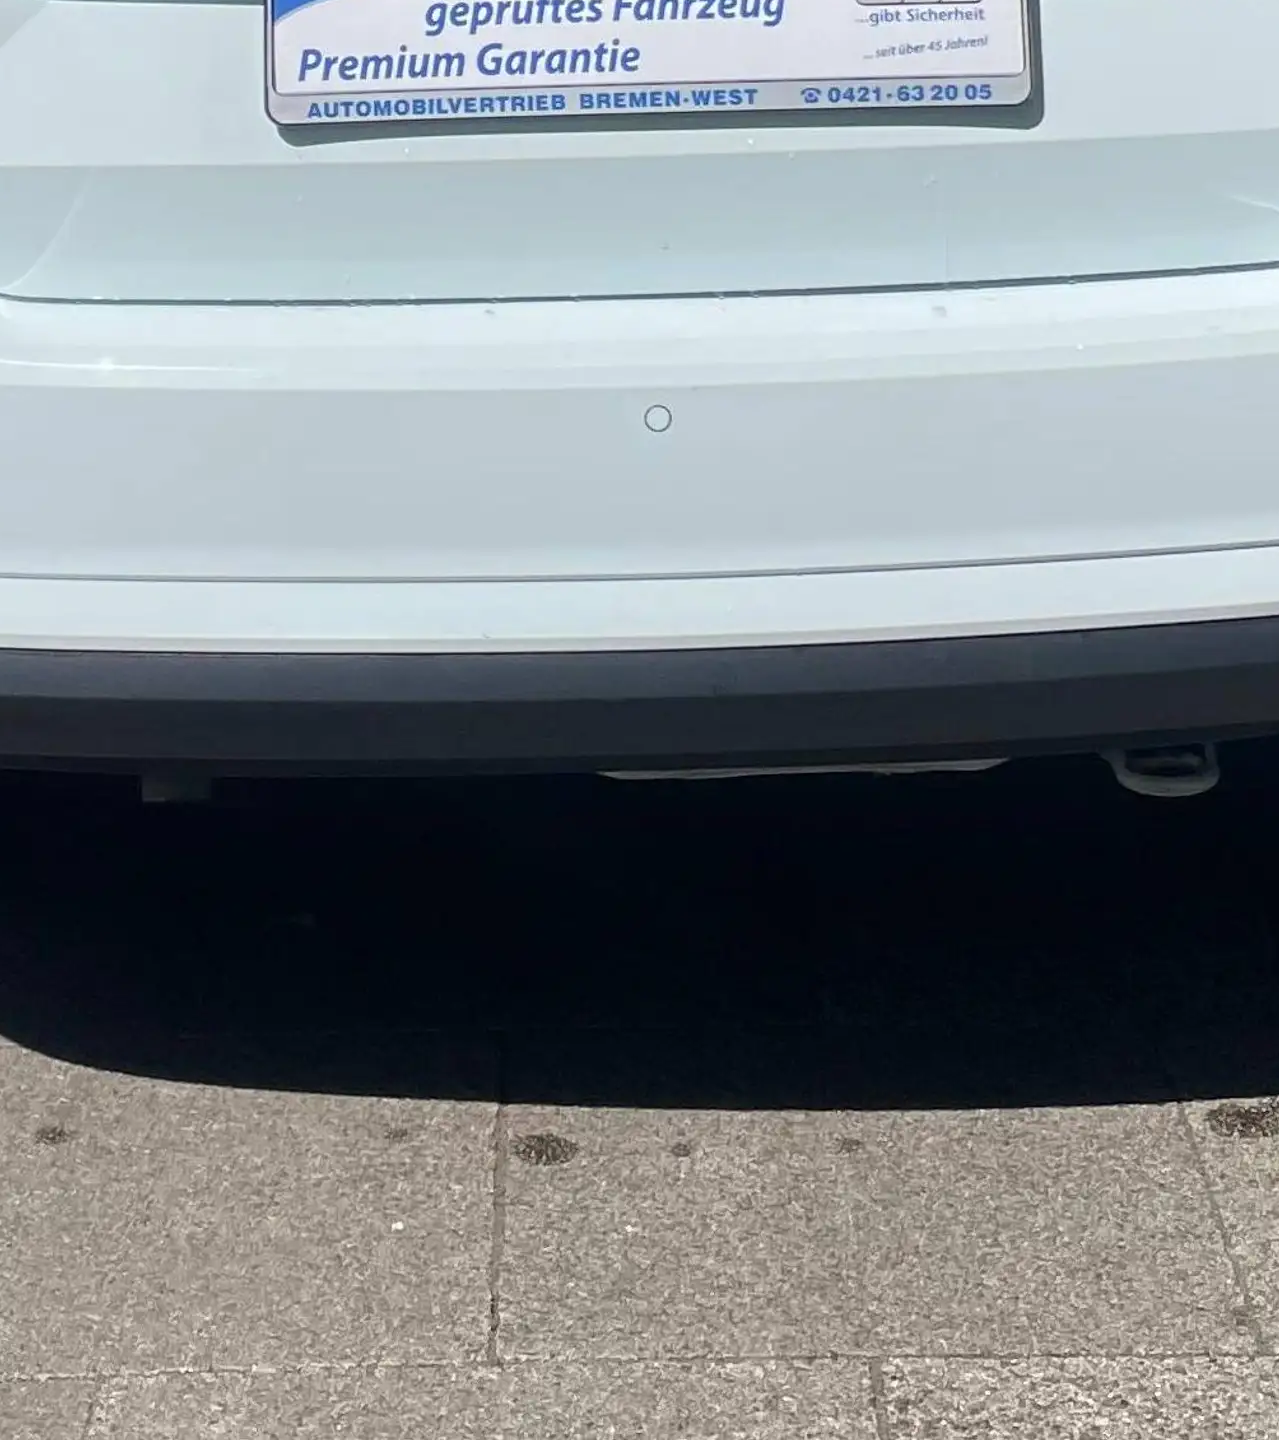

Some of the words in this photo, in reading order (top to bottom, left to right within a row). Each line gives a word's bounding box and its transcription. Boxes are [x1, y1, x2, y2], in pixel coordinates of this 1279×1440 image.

[907, 7, 986, 22] Sicherheit
[298, 45, 466, 82] Premium
[476, 38, 641, 77] Garantie
[931, 84, 960, 101] 20
[965, 83, 992, 100] 05
[307, 94, 567, 119] AUTOMOBILVERTRIEB
